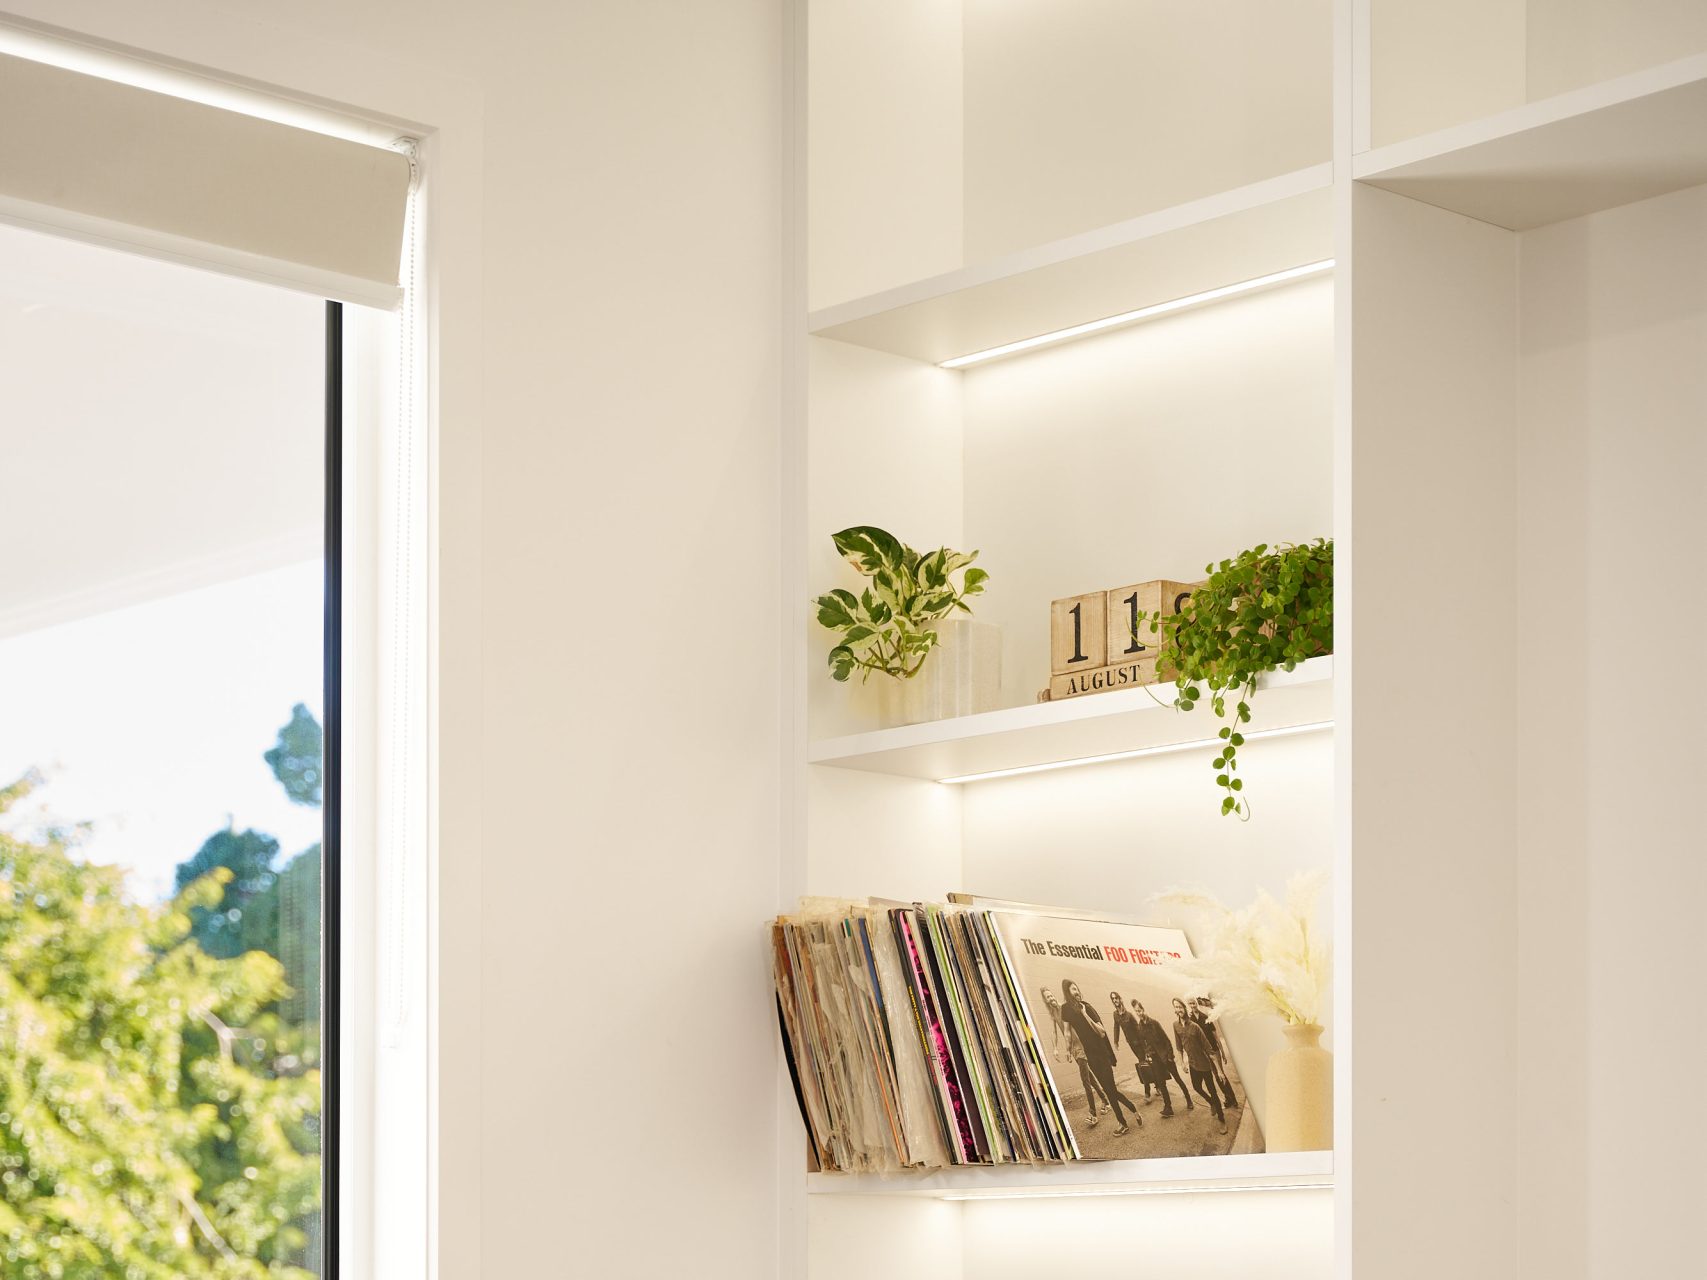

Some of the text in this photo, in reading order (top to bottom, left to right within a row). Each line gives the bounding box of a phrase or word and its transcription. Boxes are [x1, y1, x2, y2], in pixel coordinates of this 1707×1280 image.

[1066, 664, 1141, 695] AUGUST
[1021, 938, 1046, 956] The
[1046, 940, 1104, 961] Essential
[1104, 945, 1128, 963] FOO
